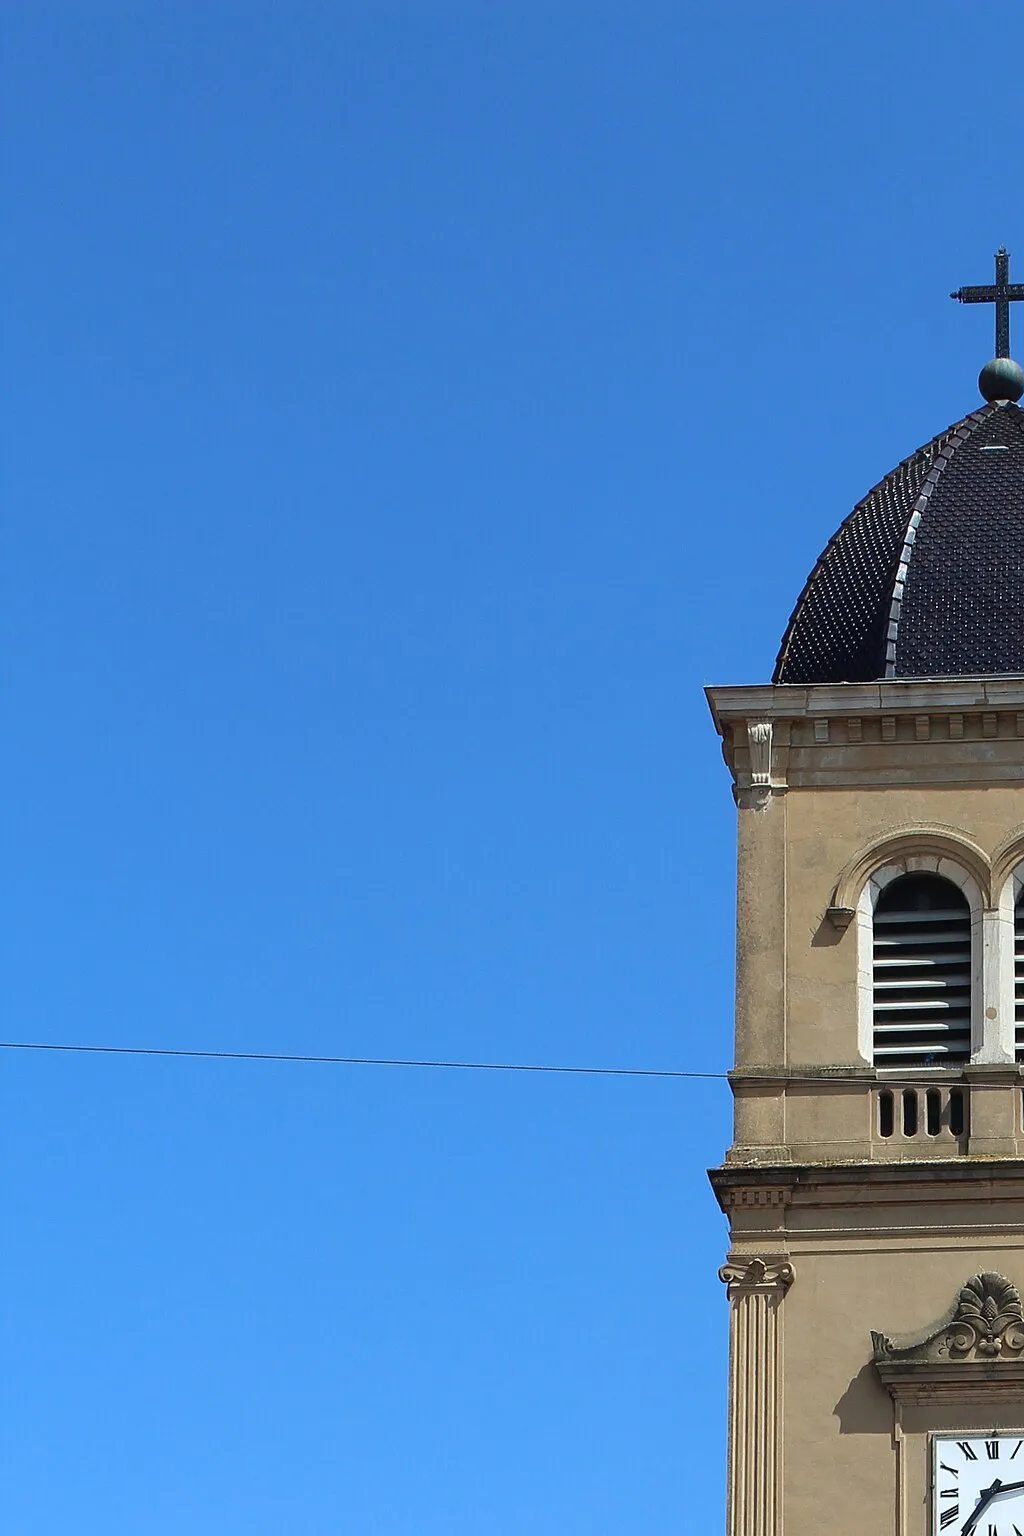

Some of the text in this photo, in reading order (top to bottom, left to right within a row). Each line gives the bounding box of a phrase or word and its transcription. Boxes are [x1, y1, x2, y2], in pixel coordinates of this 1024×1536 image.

[985, 1441, 999, 1459] XII
[1009, 1440, 1024, 1460] I
[940, 1461, 959, 1479] X
